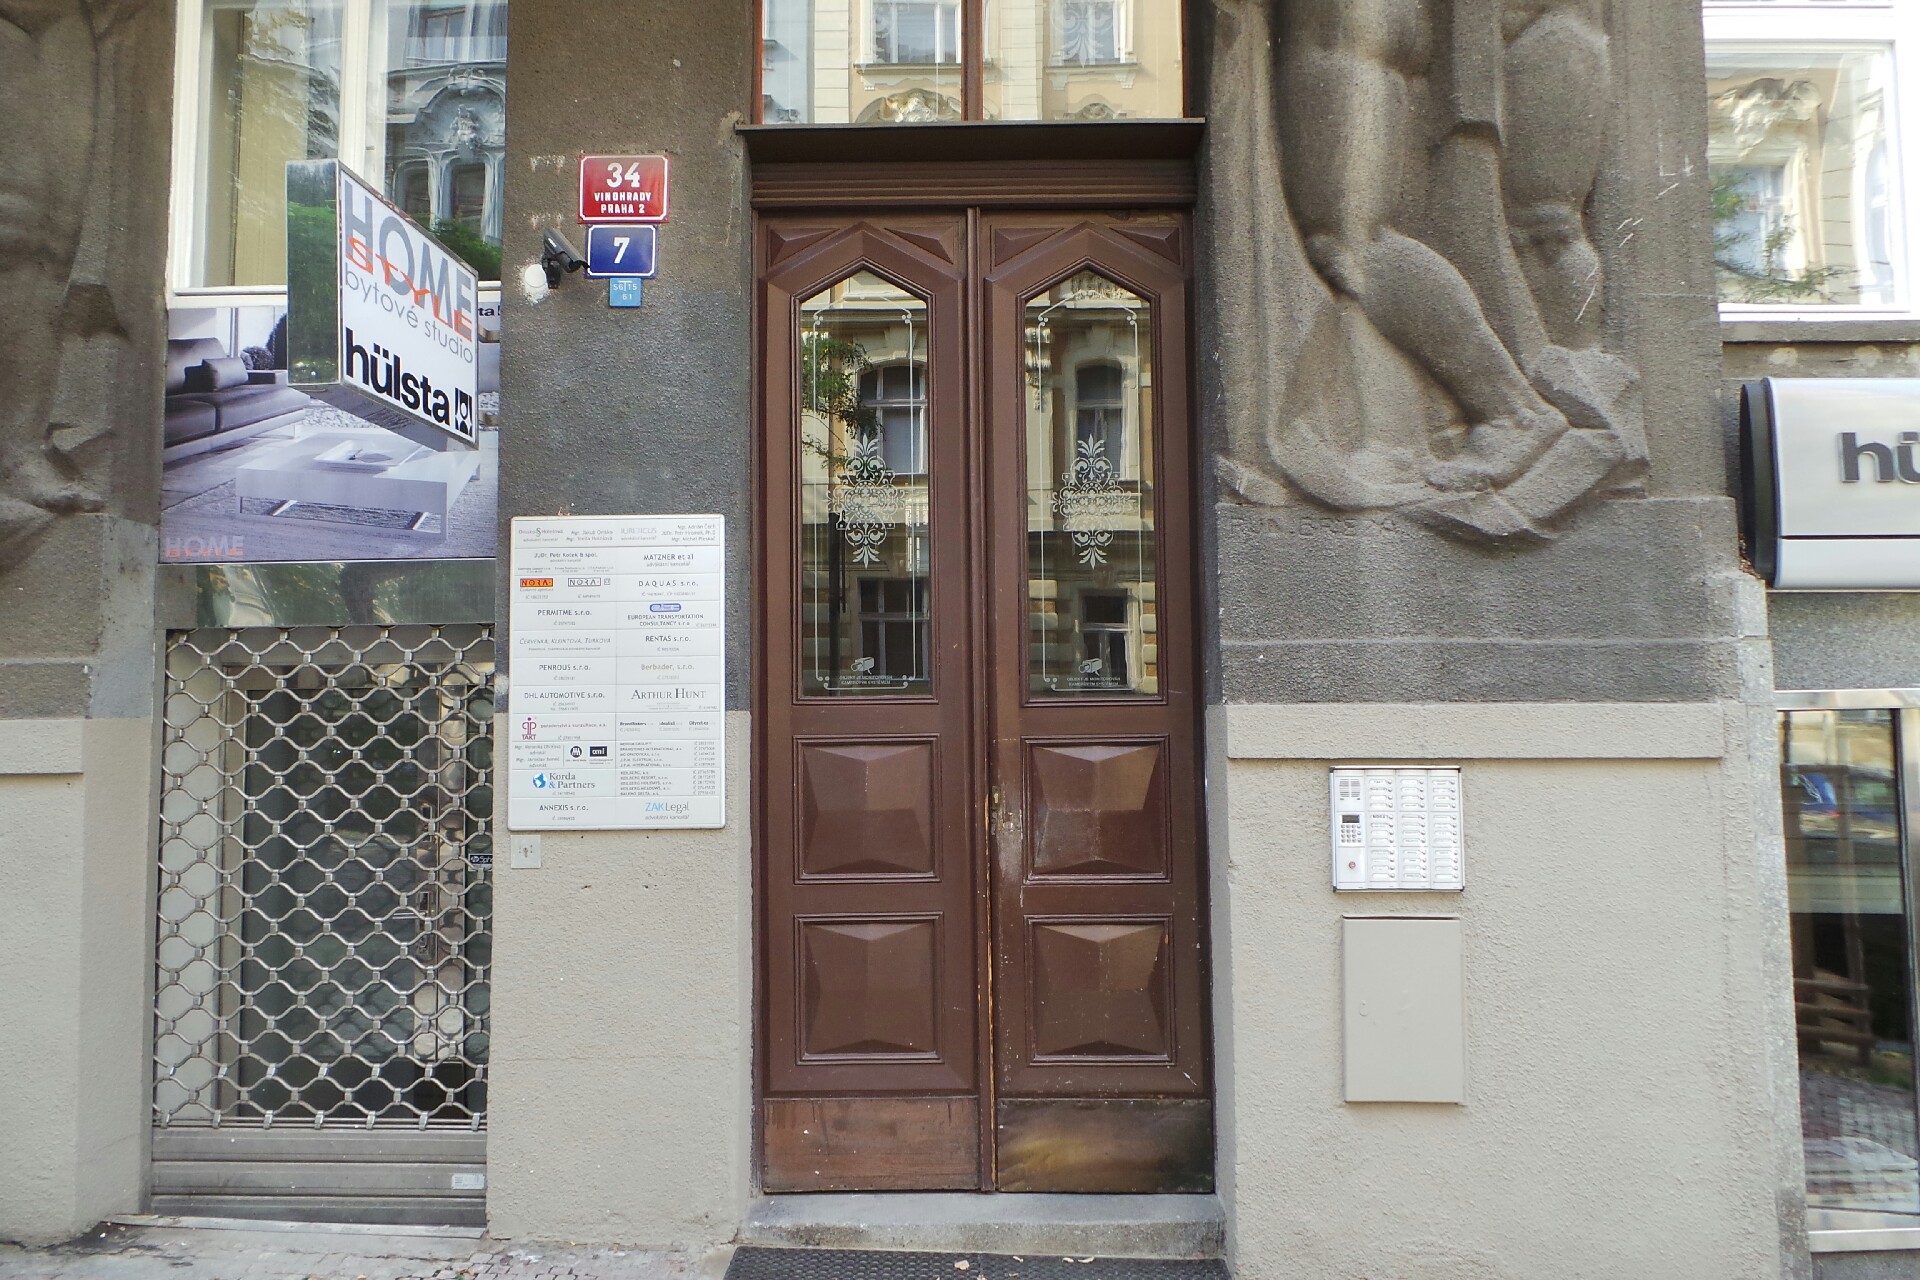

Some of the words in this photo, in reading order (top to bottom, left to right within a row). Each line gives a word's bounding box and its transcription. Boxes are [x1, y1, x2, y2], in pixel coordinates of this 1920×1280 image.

[606, 162, 641, 188] 34
[594, 191, 651, 201] VINOHRADY
[600, 204, 635, 214] PRAHA
[638, 204, 645, 213] 2
[613, 237, 630, 264] 7
[345, 180, 473, 342] HOME
[345, 236, 473, 342] STYLE
[345, 262, 419, 329] bytové
[424, 319, 474, 364] studio
[345, 326, 451, 426] hülsta
[638, 580, 677, 588] DAQUAS
[630, 689, 672, 700] ARTHUR
[675, 687, 707, 699] HUNT
[549, 772, 576, 780] Korda
[548, 781, 556, 789] &
[557, 780, 595, 789] Partners
[645, 802, 665, 811] ZAK
[665, 801, 690, 814] Legal
